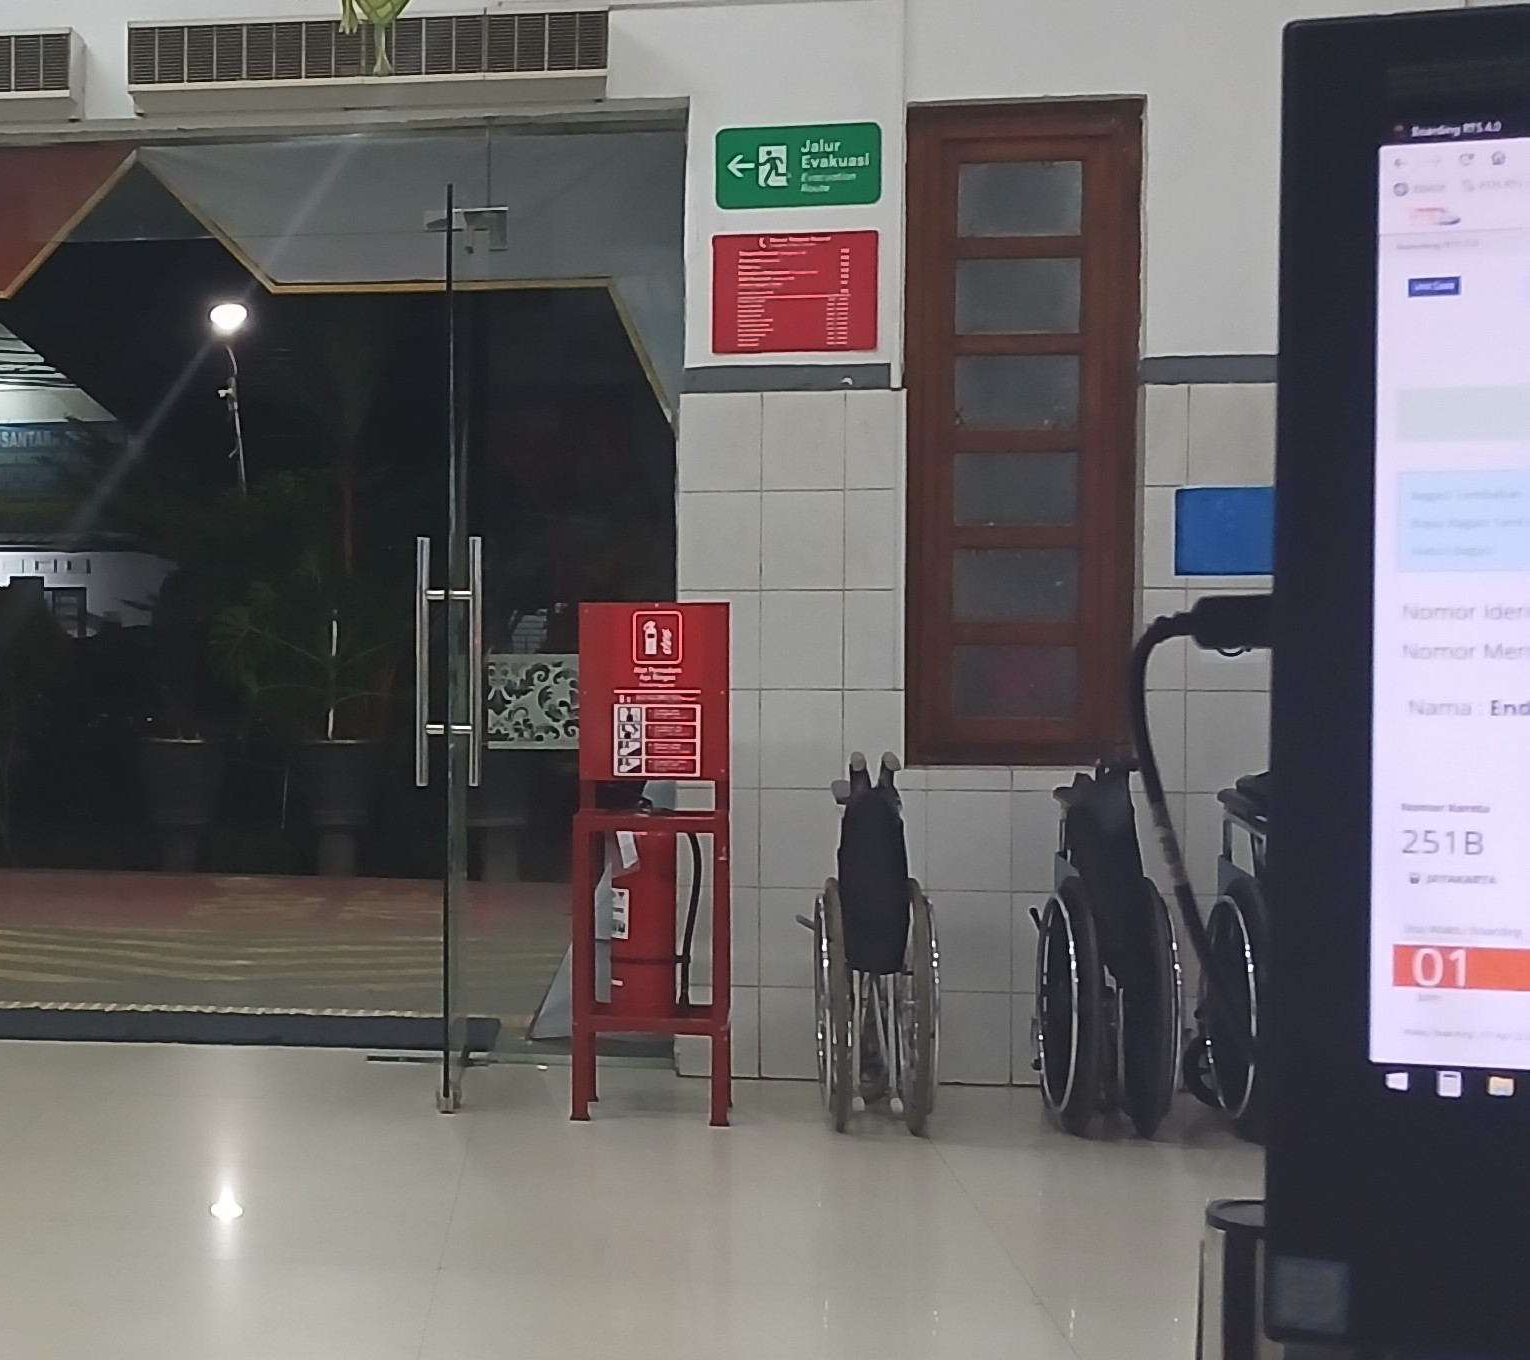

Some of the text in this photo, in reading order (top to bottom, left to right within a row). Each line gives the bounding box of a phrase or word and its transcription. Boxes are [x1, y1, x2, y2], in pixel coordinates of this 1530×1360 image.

[1412, 125, 1460, 137] Boarding
[1485, 121, 1502, 132] 4.0
[801, 139, 841, 153] Jalur
[801, 153, 870, 169] Evakuasi
[1402, 604, 1475, 621] Nomor
[1402, 643, 1475, 660] Nomor
[1409, 700, 1472, 717] Nama
[1401, 829, 1485, 856] 251B
[1411, 947, 1467, 988] 01
